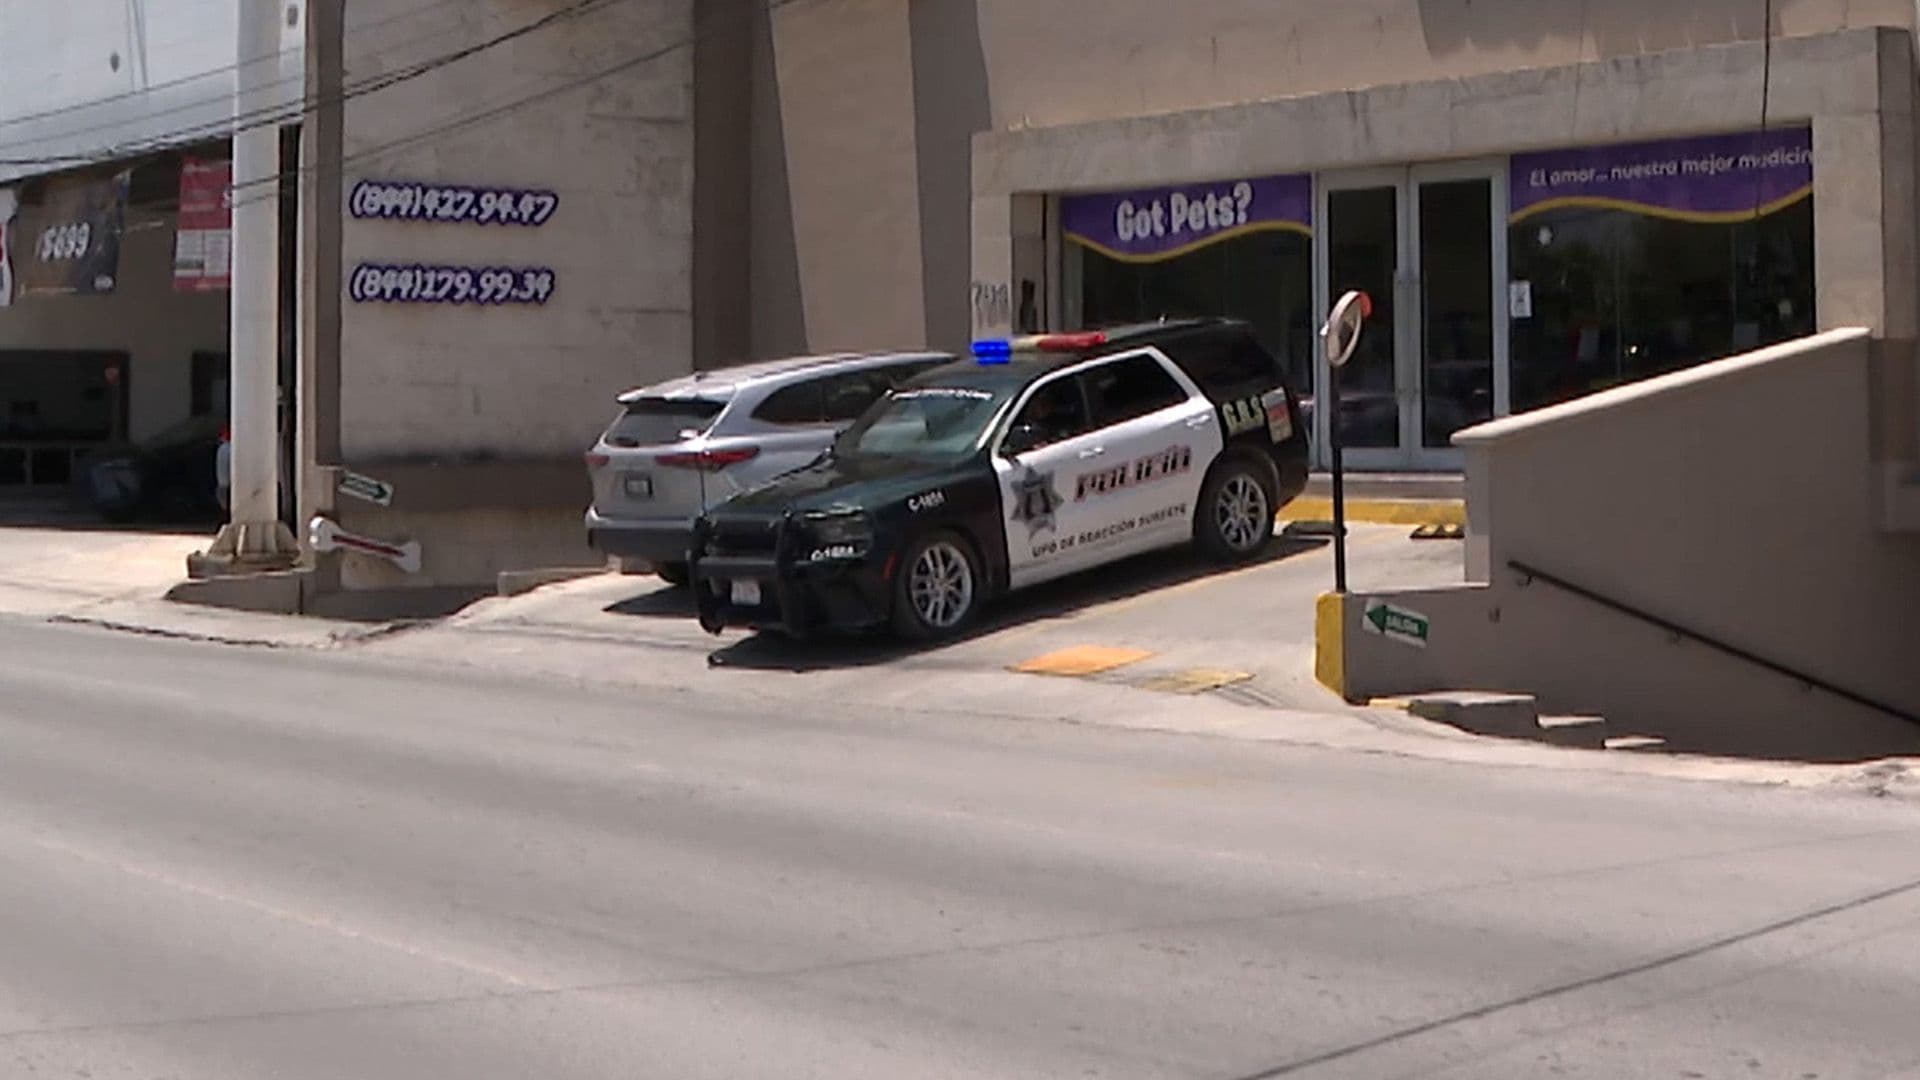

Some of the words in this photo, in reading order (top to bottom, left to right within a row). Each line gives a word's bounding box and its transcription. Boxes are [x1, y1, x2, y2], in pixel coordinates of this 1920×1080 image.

[1610, 162, 1677, 181] nuestra
[1681, 154, 1733, 177] mejor
[1116, 199, 1165, 242] Got
[1170, 181, 1252, 234] Pets?
